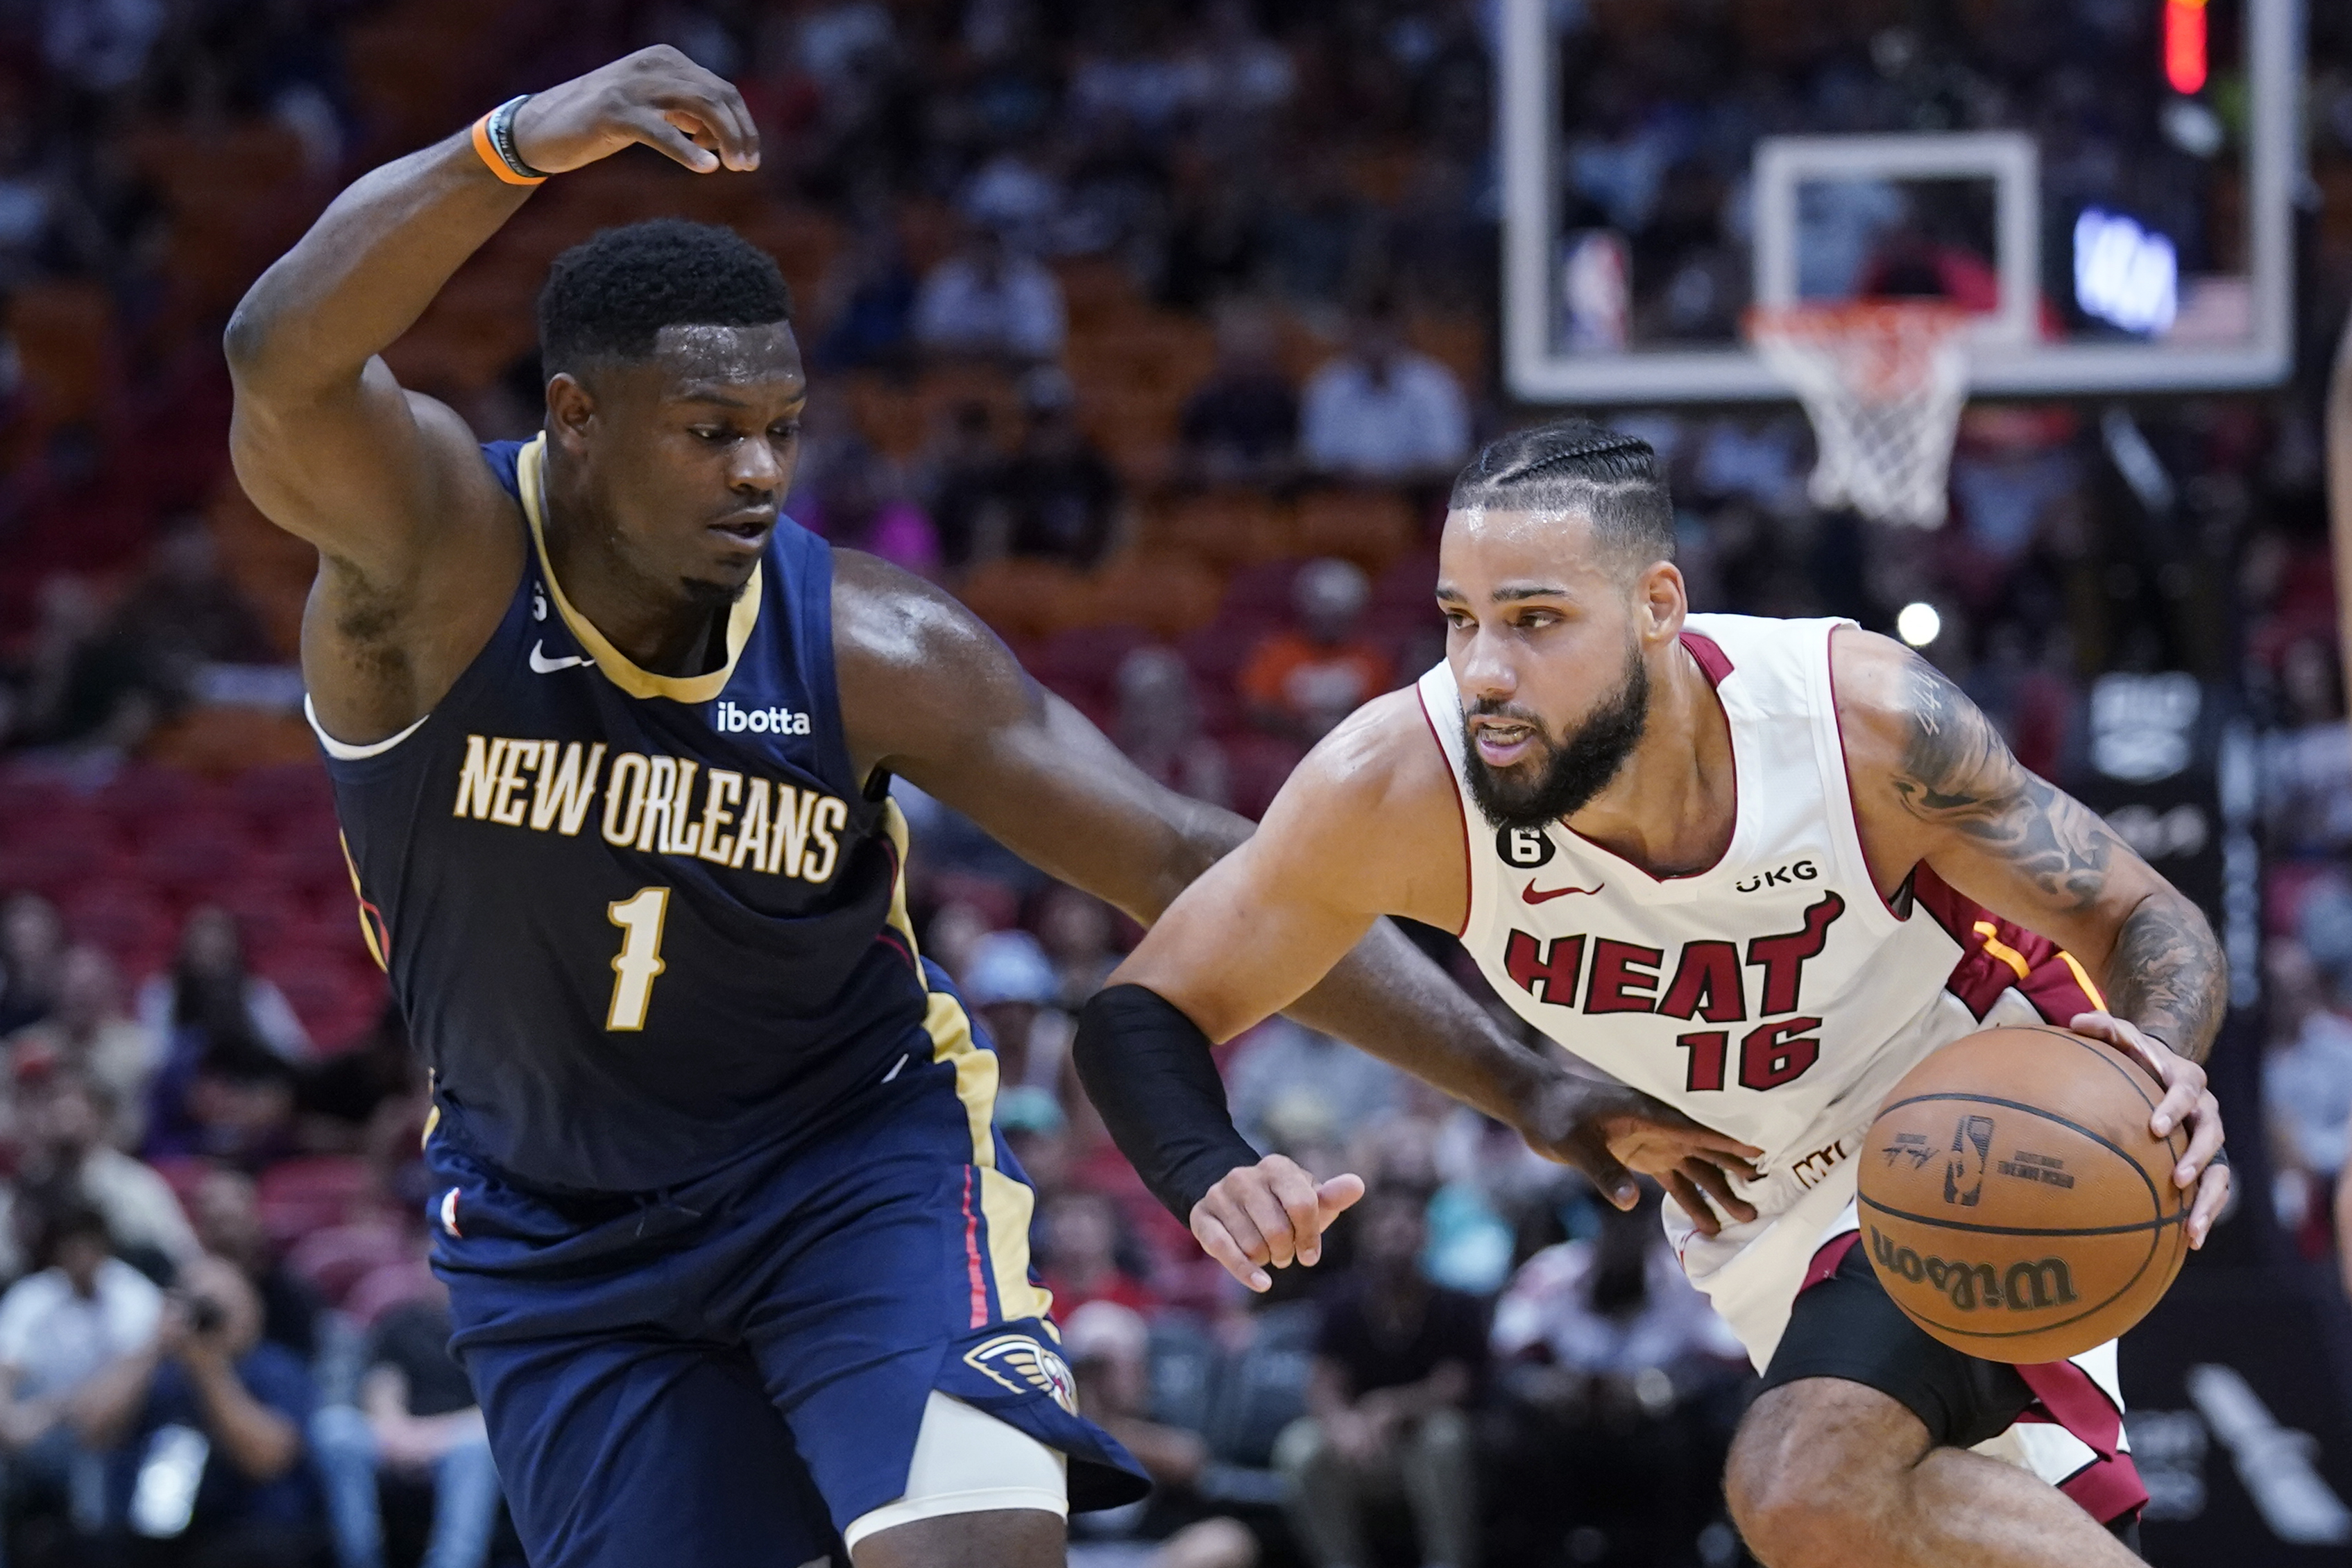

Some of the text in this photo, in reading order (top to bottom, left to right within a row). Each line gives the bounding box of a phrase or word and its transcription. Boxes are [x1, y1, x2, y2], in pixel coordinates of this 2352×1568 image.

[717, 701, 811, 735] ibotta
[453, 735, 849, 883] NEW ORLEANS
[1510, 828, 1541, 862] 6
[607, 887, 670, 1031] 1
[1504, 889, 1846, 1023] HEAT
[1676, 1016, 1823, 1092] 16
[1870, 1224, 2078, 1311] Wilson
